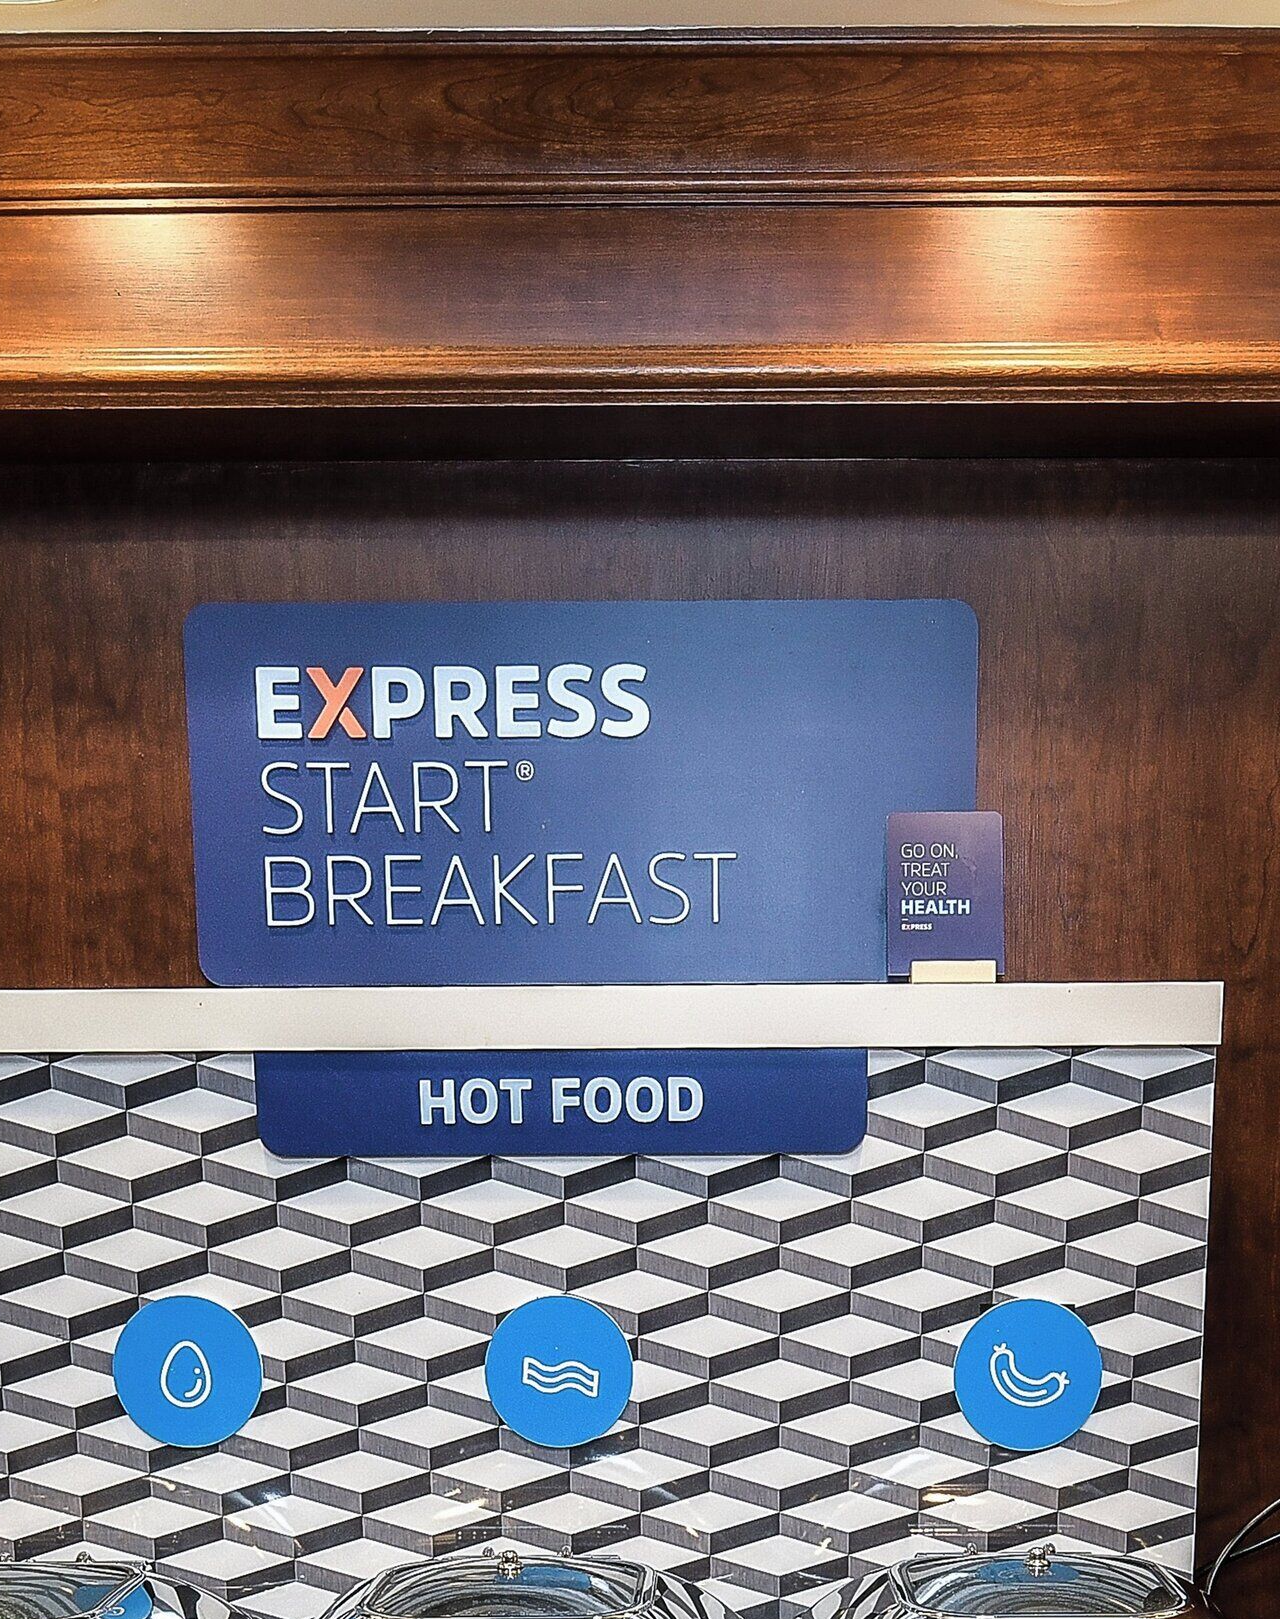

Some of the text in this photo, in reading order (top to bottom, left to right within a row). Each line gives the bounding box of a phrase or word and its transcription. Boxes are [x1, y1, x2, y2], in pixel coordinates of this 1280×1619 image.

[254, 662, 651, 741] EXPRESS
[900, 843, 959, 860] GO ON,
[900, 862, 951, 878] TREAT
[264, 851, 739, 928] BREAKFAST
[901, 881, 948, 896] YOUR
[900, 899, 971, 915] HEALTH
[418, 1075, 705, 1126] HOT FOOD
